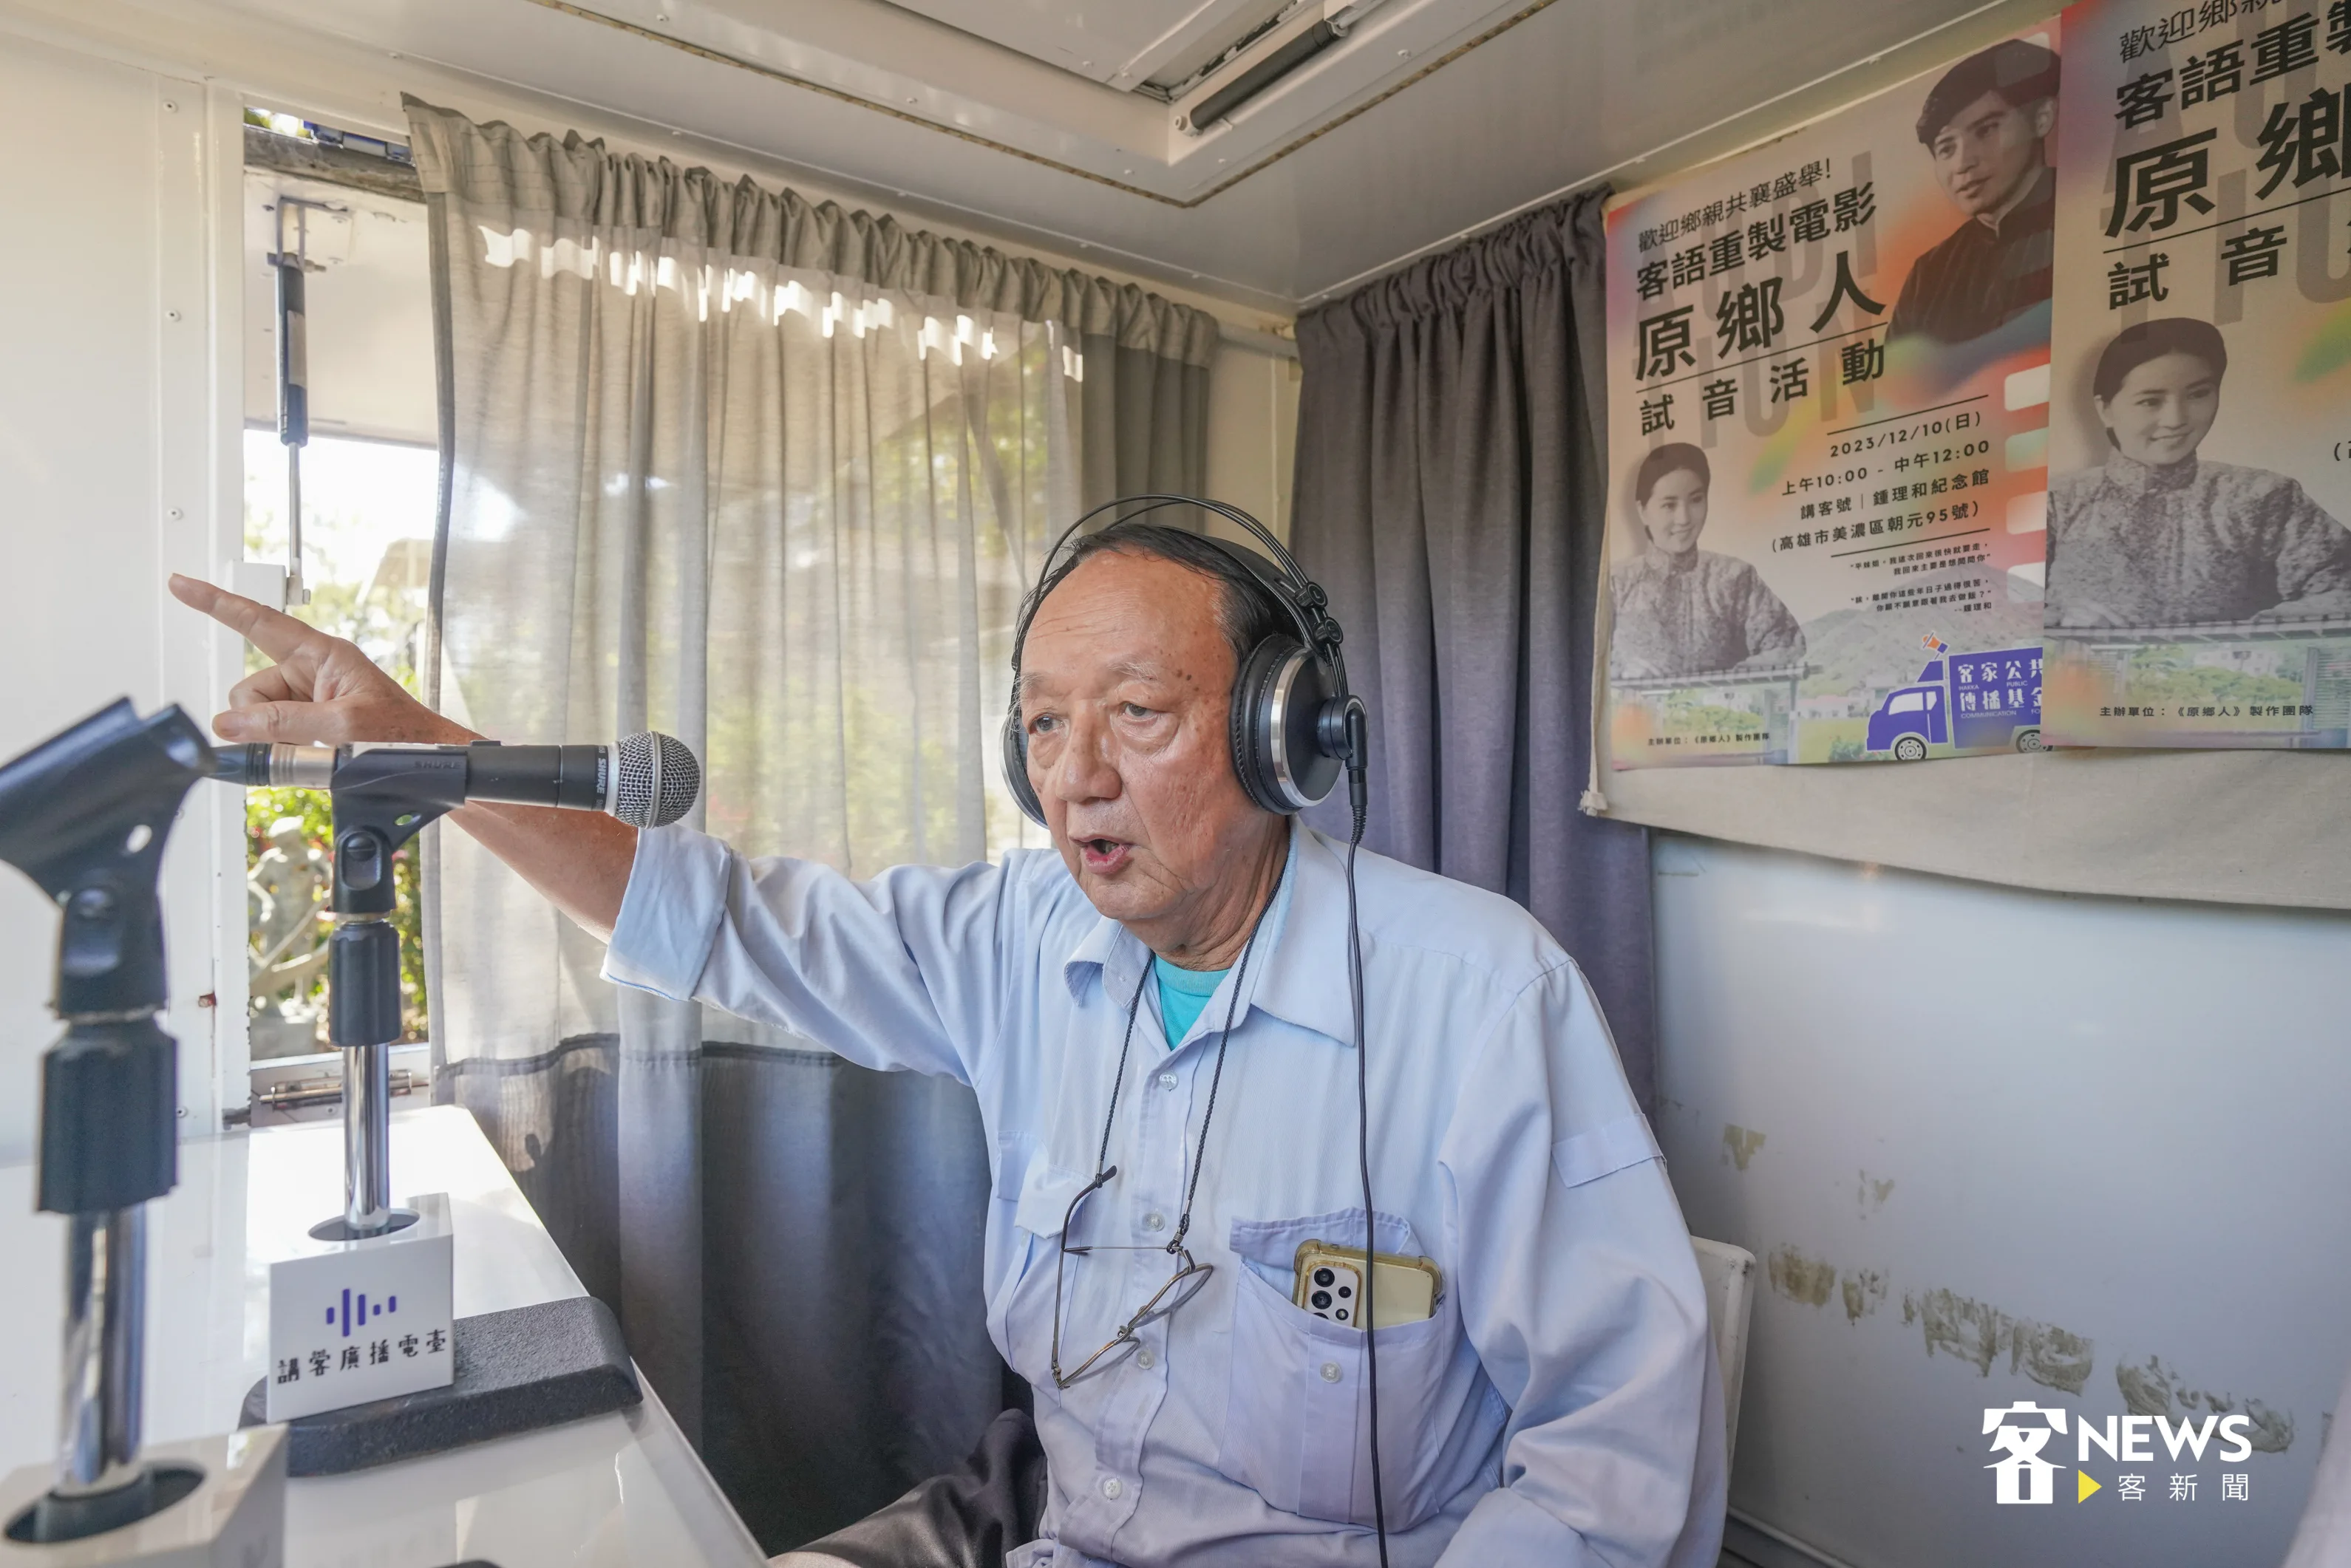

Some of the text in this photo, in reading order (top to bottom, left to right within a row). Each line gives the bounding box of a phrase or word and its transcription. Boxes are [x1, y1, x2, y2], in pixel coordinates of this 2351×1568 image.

[1638, 157, 1831, 253] 歡迎鄉親共襄盛舉!
[2104, 83, 2351, 238] 原鄉
[1636, 181, 1877, 301] 客語重製電影
[2107, 220, 2351, 310] 試音
[1636, 250, 1888, 381] 原鄉人
[1639, 338, 1885, 436] 試音活動
[1782, 467, 1868, 496] 上午10:00
[1894, 439, 1990, 473] 中午12:00
[1958, 658, 2043, 684] 客家公共
[1960, 710, 2017, 719] COMMUNICATION
[412, 760, 461, 770] SHURE
[596, 757, 607, 794] SHURE
